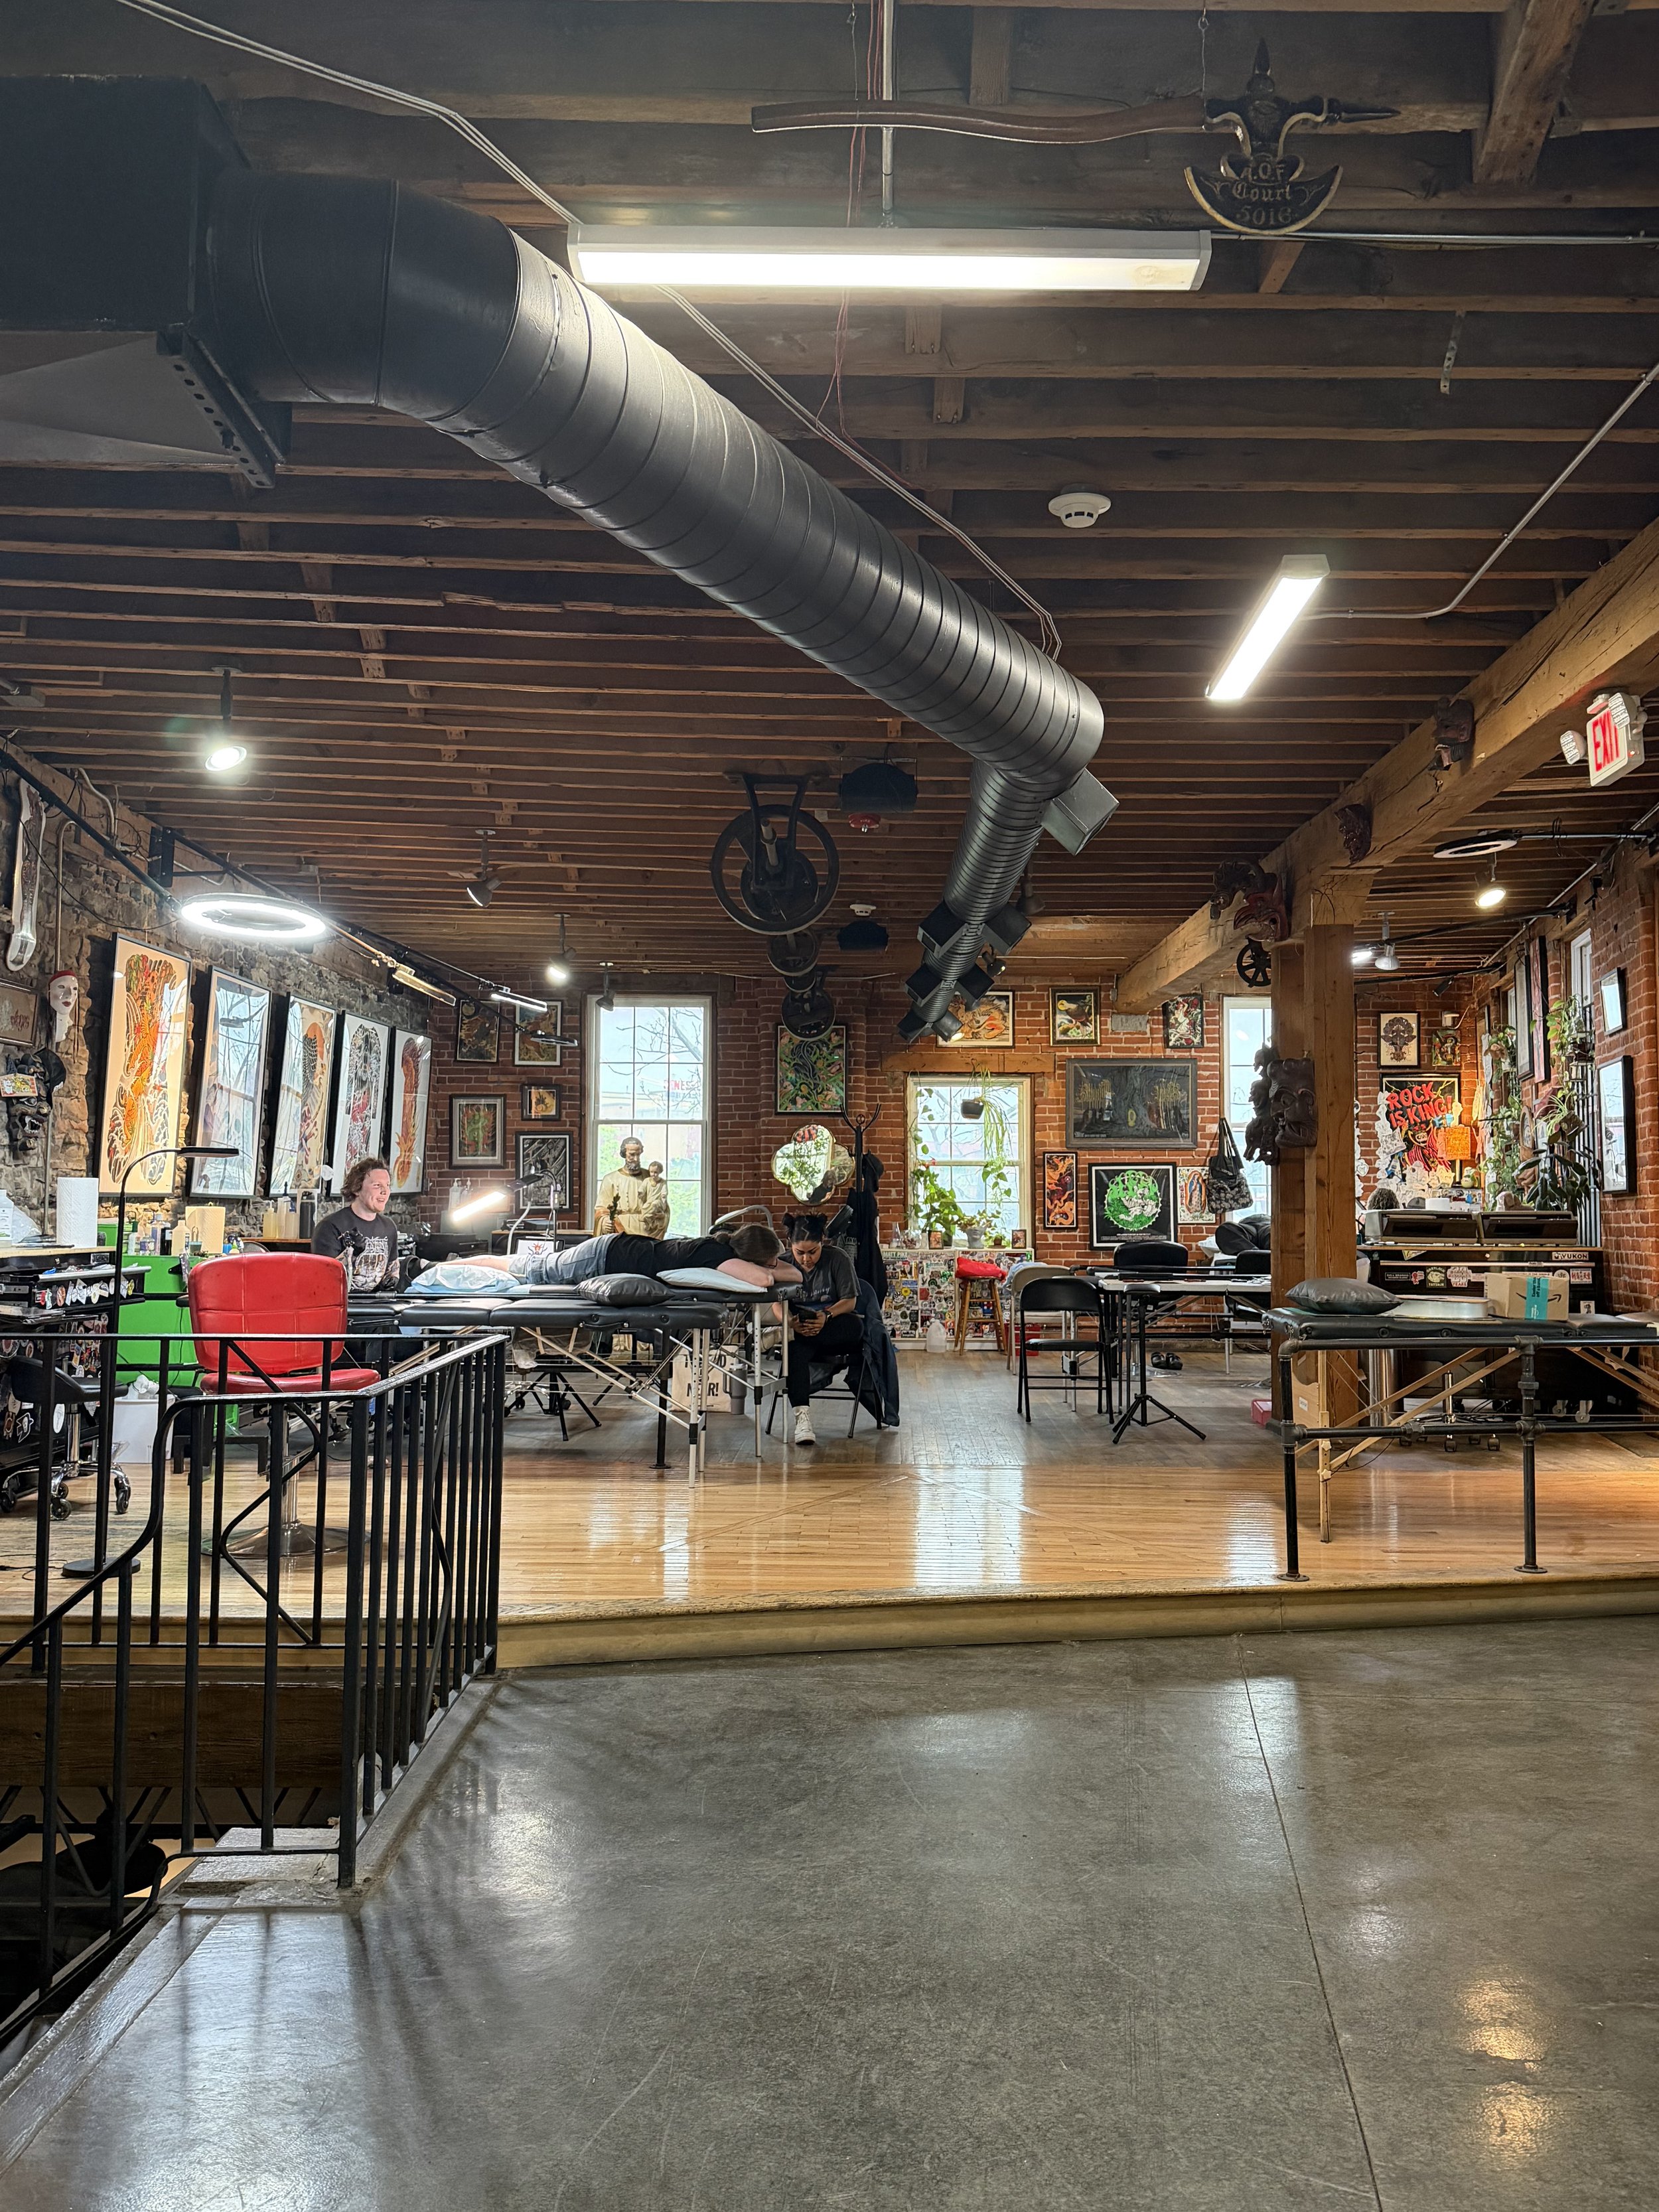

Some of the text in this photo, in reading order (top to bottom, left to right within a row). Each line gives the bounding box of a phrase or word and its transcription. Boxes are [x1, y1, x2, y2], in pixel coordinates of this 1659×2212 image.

[1232, 181, 1291, 202] Court
[1386, 1081, 1437, 1110] ROCK
[1389, 1095, 1452, 1128] IS KING!
[686, 1382, 719, 1396] NR!
